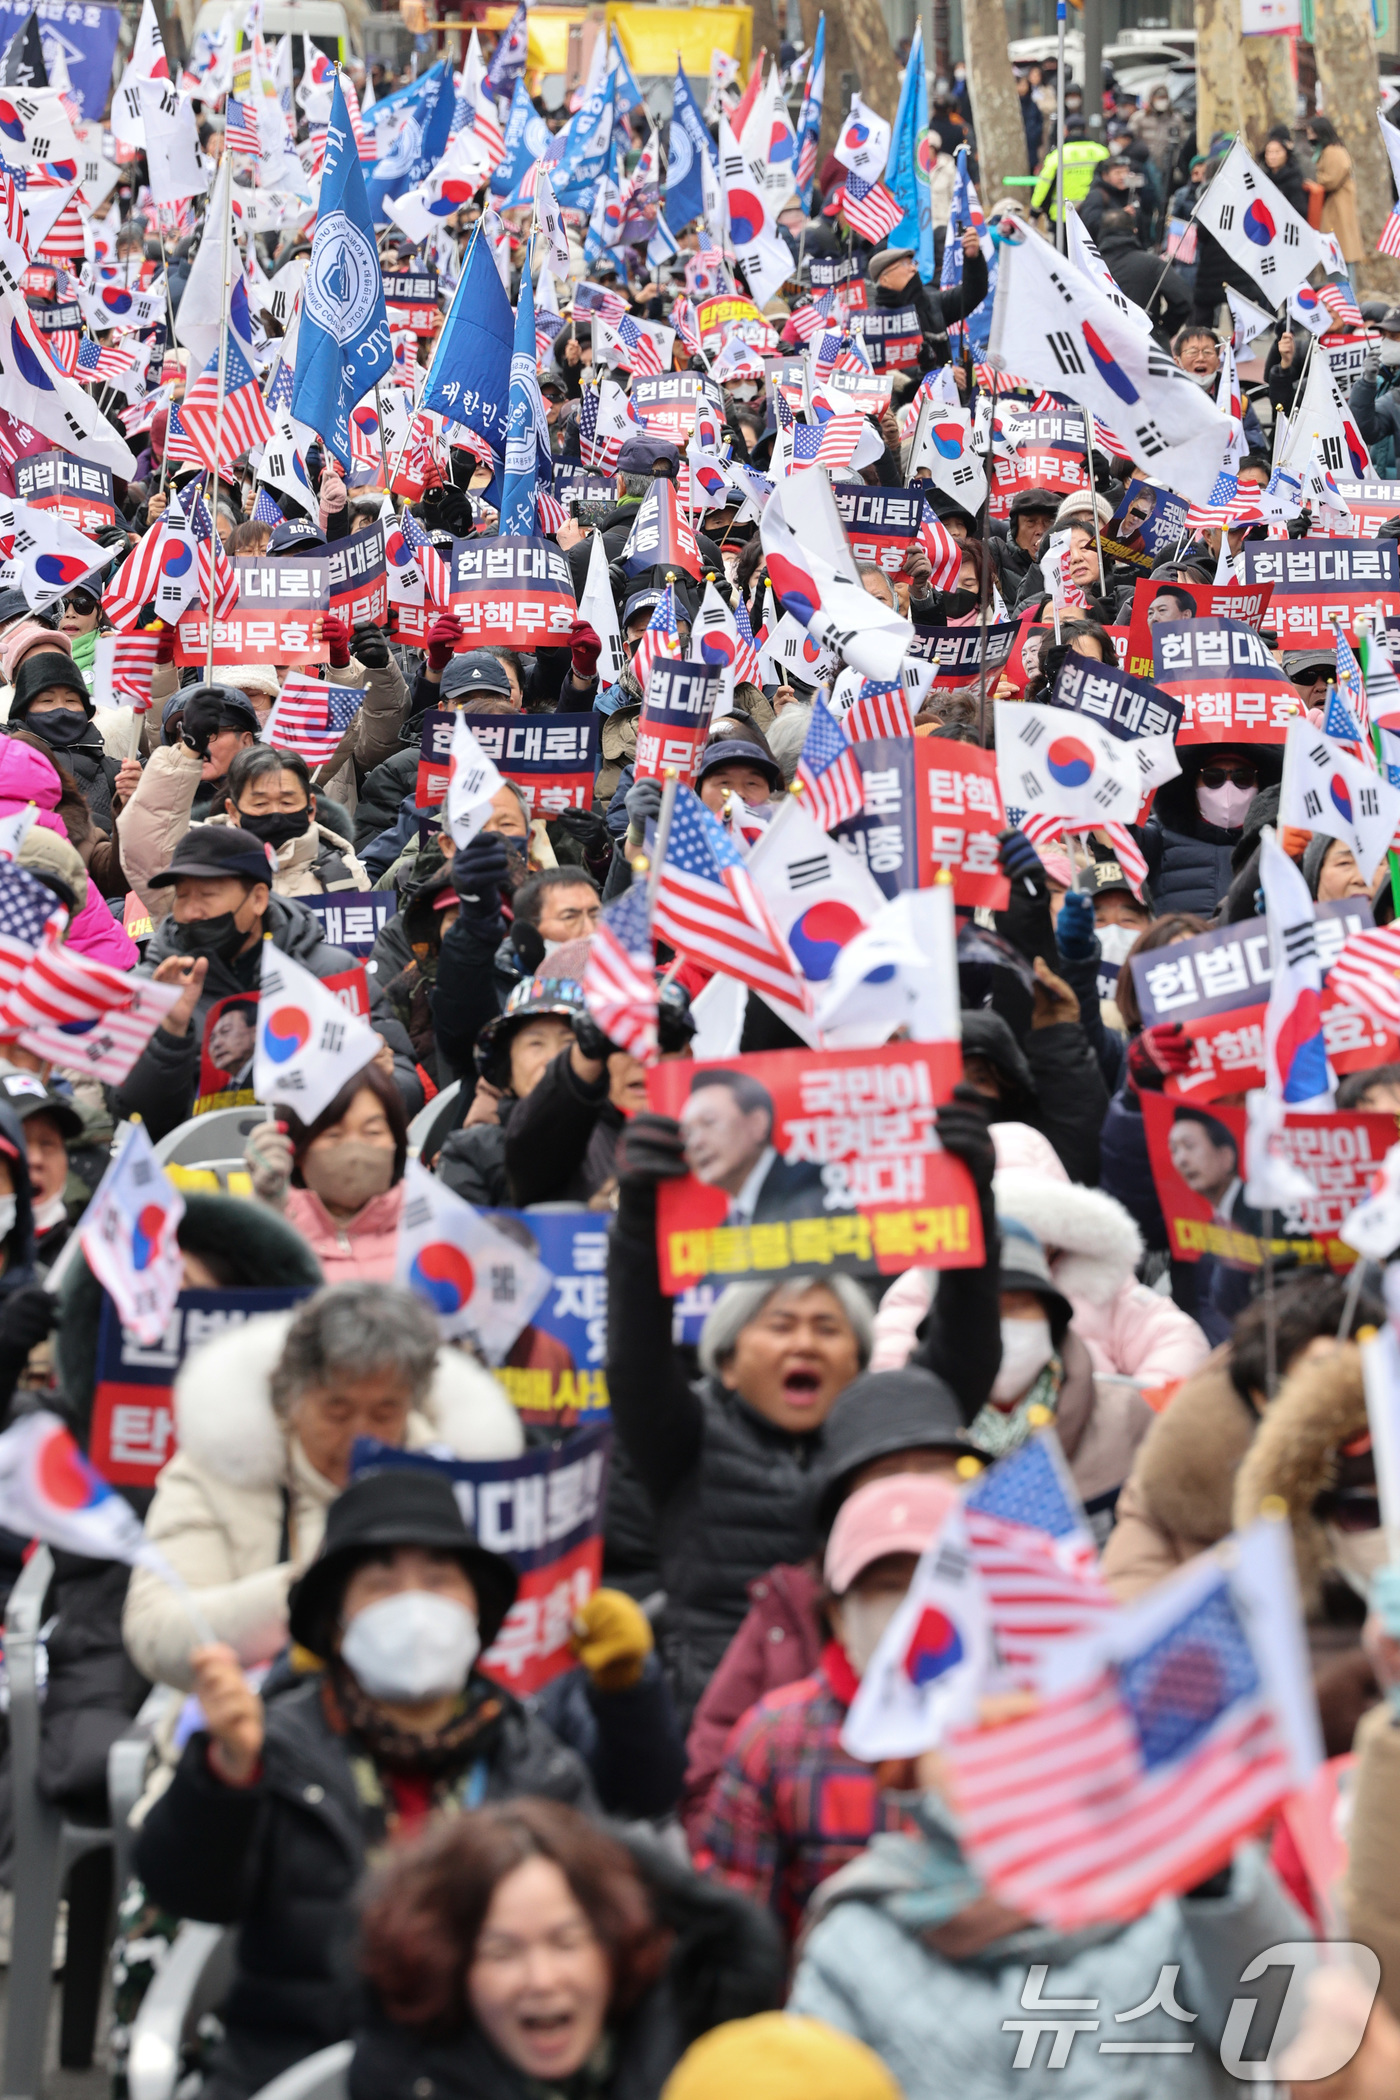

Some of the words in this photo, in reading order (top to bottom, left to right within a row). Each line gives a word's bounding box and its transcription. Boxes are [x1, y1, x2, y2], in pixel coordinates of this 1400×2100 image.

[382, 276, 436, 299] 법대로!
[31, 305, 82, 328] 법대로!
[700, 301, 771, 332] 탄핵무
[850, 310, 919, 336] 헌법대로!
[833, 376, 888, 391] 대로!
[1022, 418, 1086, 443] 법대로
[17, 461, 110, 497] 헌법대로!
[993, 455, 1089, 488] 탄핵무효!
[1337, 483, 1400, 501] 법대
[42, 504, 112, 537] 무효!
[834, 494, 919, 527] 법대로!
[289, 525, 318, 537] ROTC
[328, 531, 384, 586] 법대로!
[853, 543, 906, 573] 무효
[1252, 550, 1392, 584] 헌법대로!
[233, 568, 322, 598] 대로!
[328, 585, 385, 630] 핵무효!
[1210, 593, 1262, 617] 국민이
[179, 620, 322, 654] 탄핵무효!
[906, 631, 1015, 666] 헌법대로!
[648, 669, 719, 715] 법대로
[927, 768, 1001, 821] 탄핵
[930, 825, 1001, 876] 무효
[312, 906, 388, 945] 대로!
[800, 1060, 935, 1117] 국민이
[821, 1156, 925, 1211] 있다!
